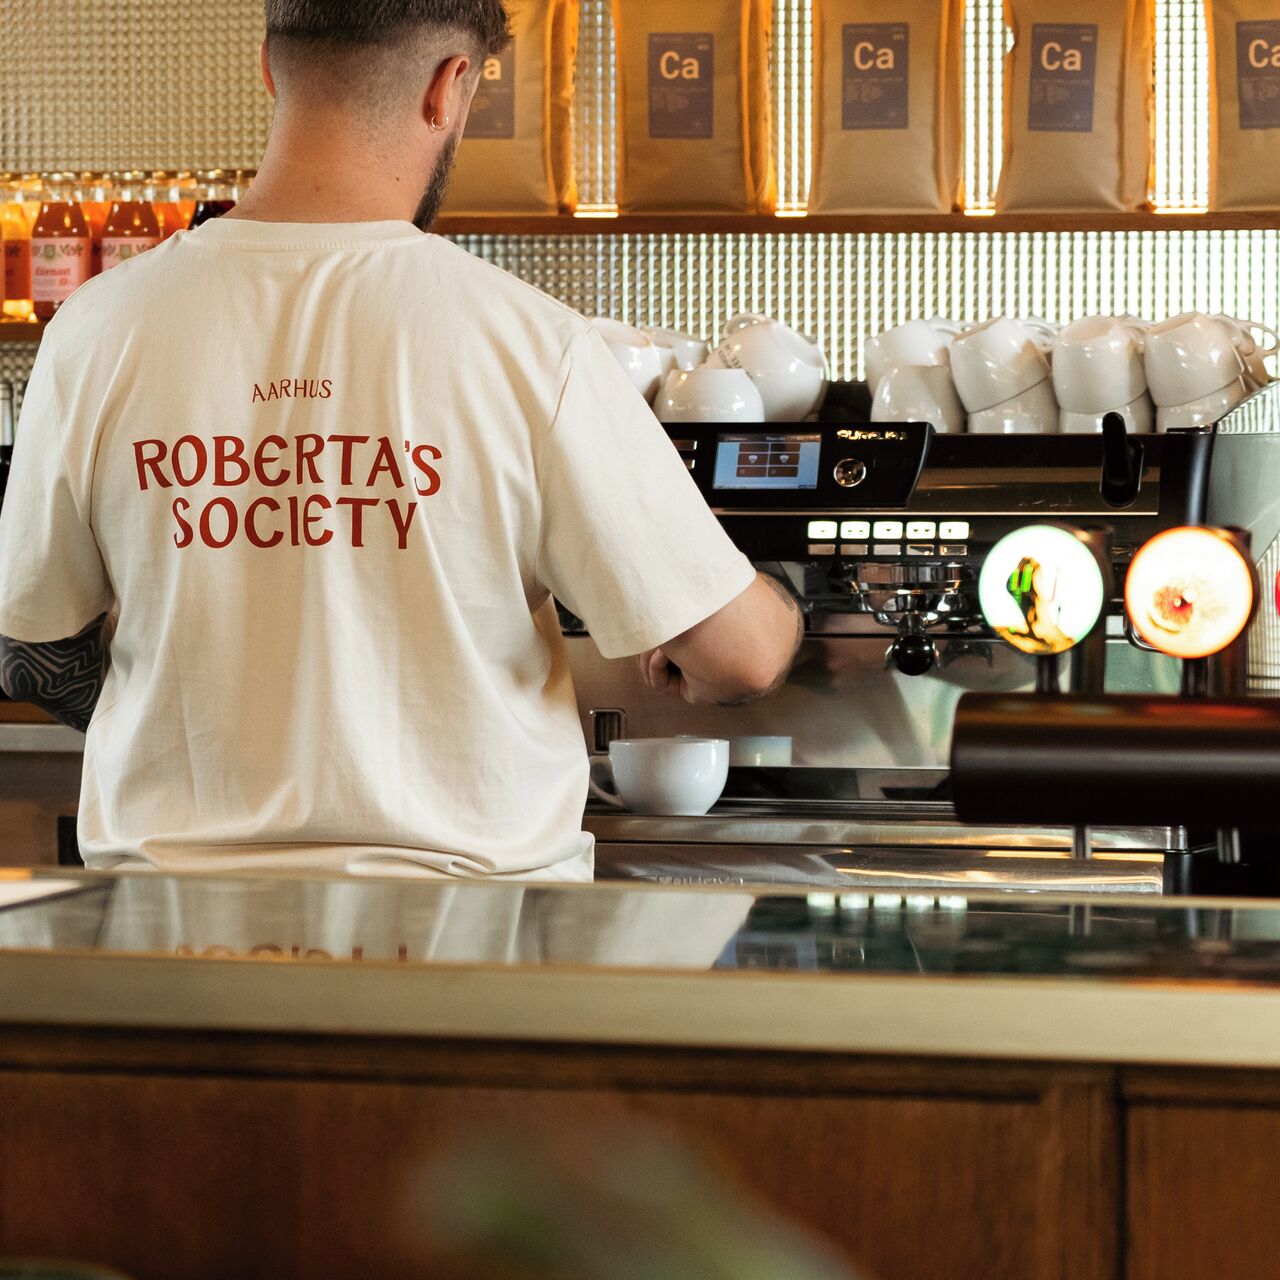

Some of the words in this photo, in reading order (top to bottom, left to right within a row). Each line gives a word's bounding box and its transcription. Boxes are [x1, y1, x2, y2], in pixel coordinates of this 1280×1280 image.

[659, 51, 700, 80] Ca
[853, 42, 895, 70] Ca
[1041, 42, 1082, 71] Ca
[252, 379, 332, 403] AARHUS
[133, 433, 443, 496] ROBERTA'S
[173, 494, 418, 549] SOCIETY
